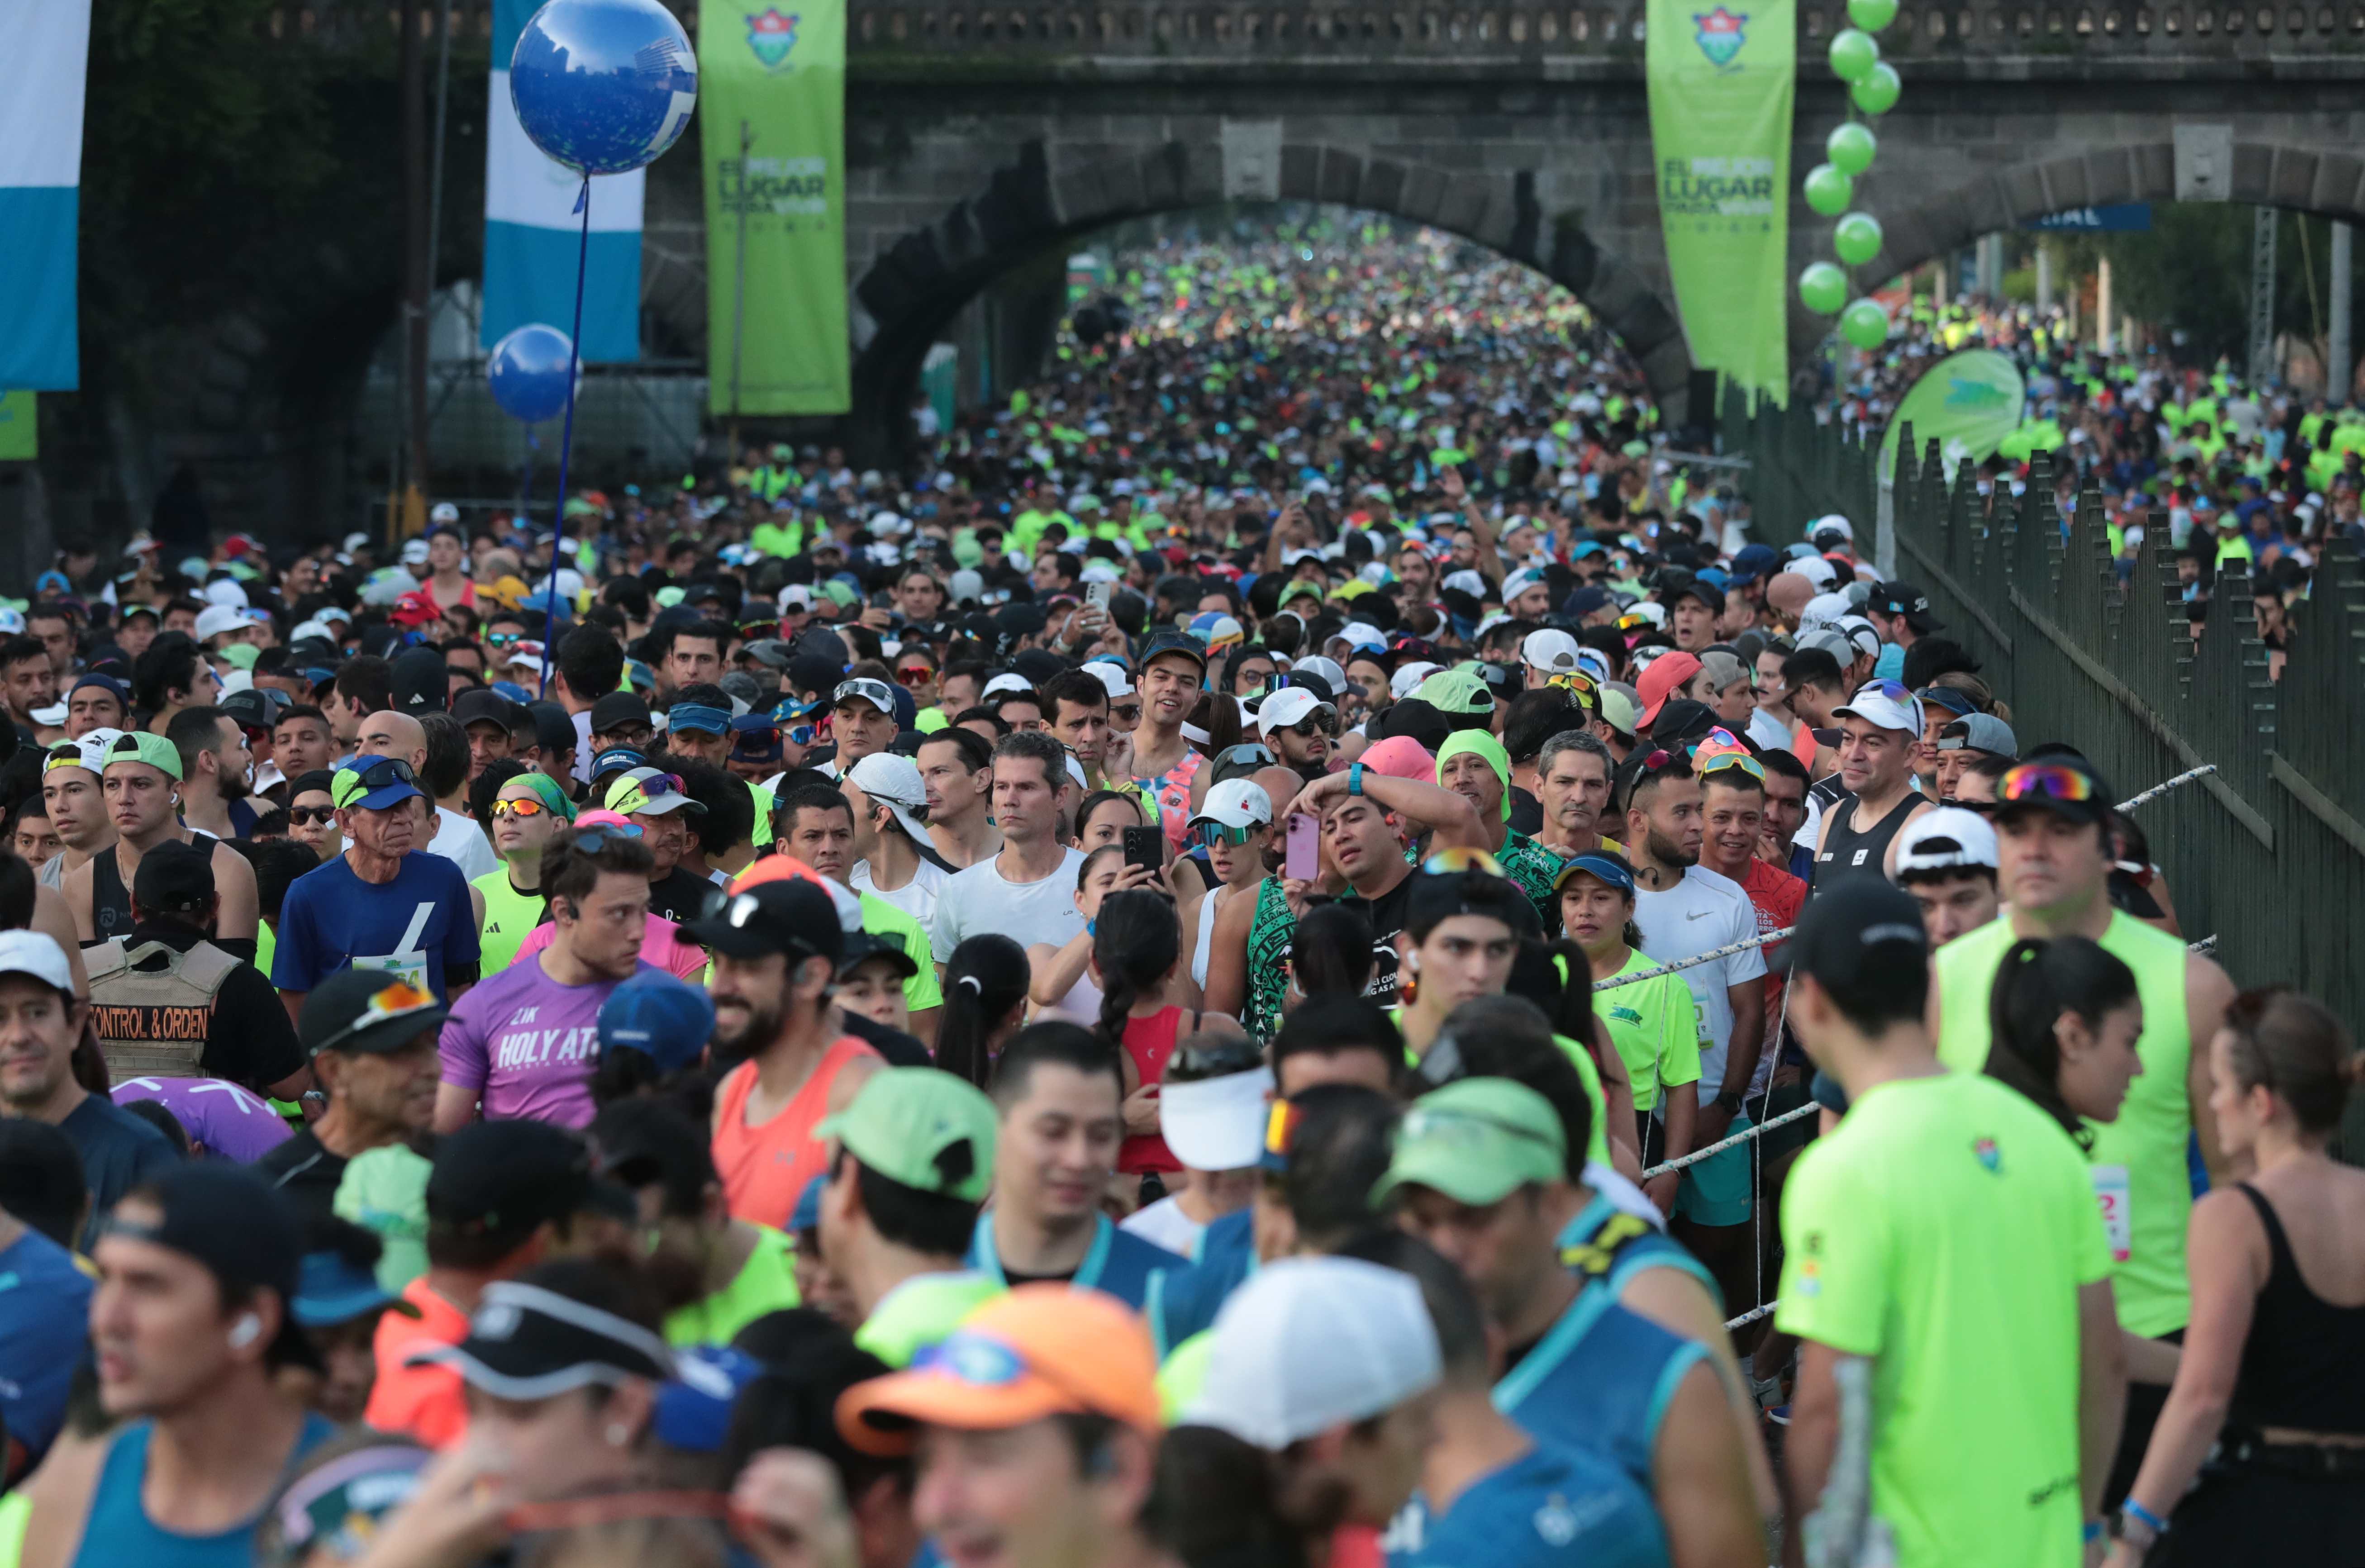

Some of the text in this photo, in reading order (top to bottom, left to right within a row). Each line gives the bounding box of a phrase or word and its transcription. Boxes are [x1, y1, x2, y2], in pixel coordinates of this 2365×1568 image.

[1665, 157, 1773, 176] EL MEJOR
[719, 176, 824, 198] LUGAR
[1665, 176, 1772, 199] LUGAR
[1381, 971, 1400, 984] CLOU
[90, 1006, 208, 1040] ONTROL & ORDEN
[509, 1007, 540, 1026] 21K
[498, 1027, 600, 1069] HOLY AT
